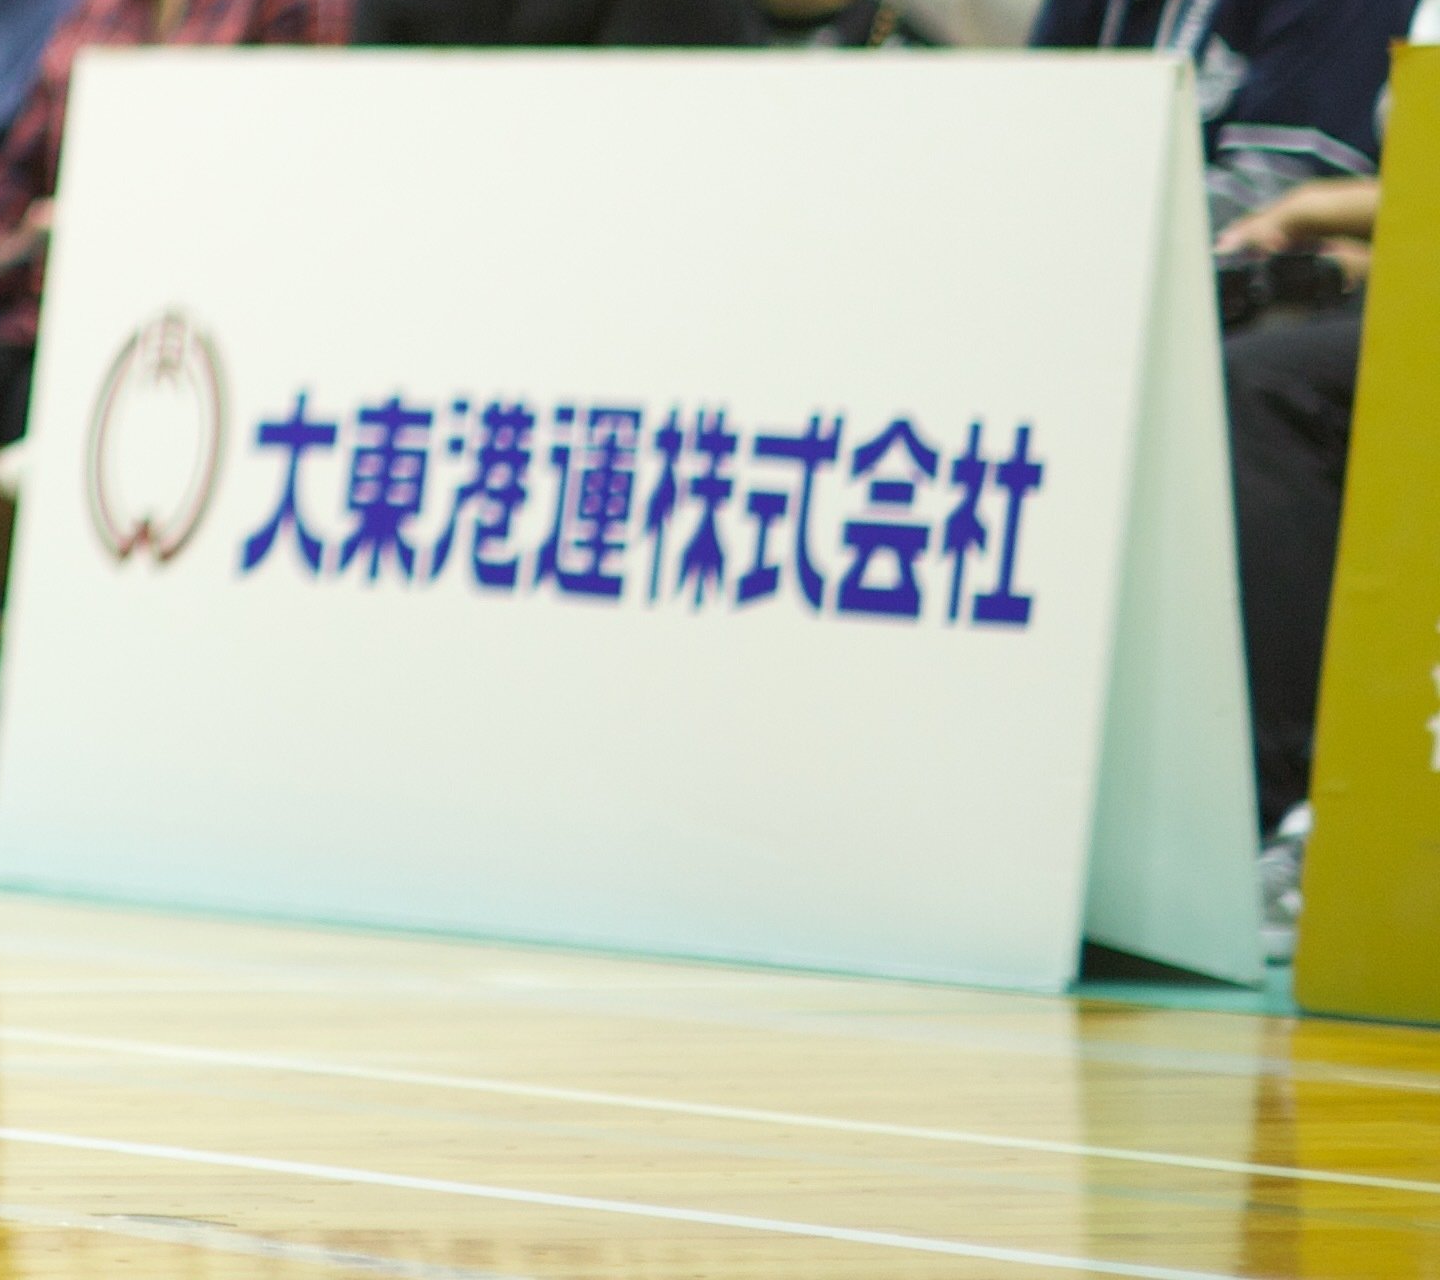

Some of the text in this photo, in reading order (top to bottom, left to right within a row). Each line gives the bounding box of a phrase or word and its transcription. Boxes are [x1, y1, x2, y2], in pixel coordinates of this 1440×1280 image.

[236, 390, 1046, 630] 大東港運株式会社
